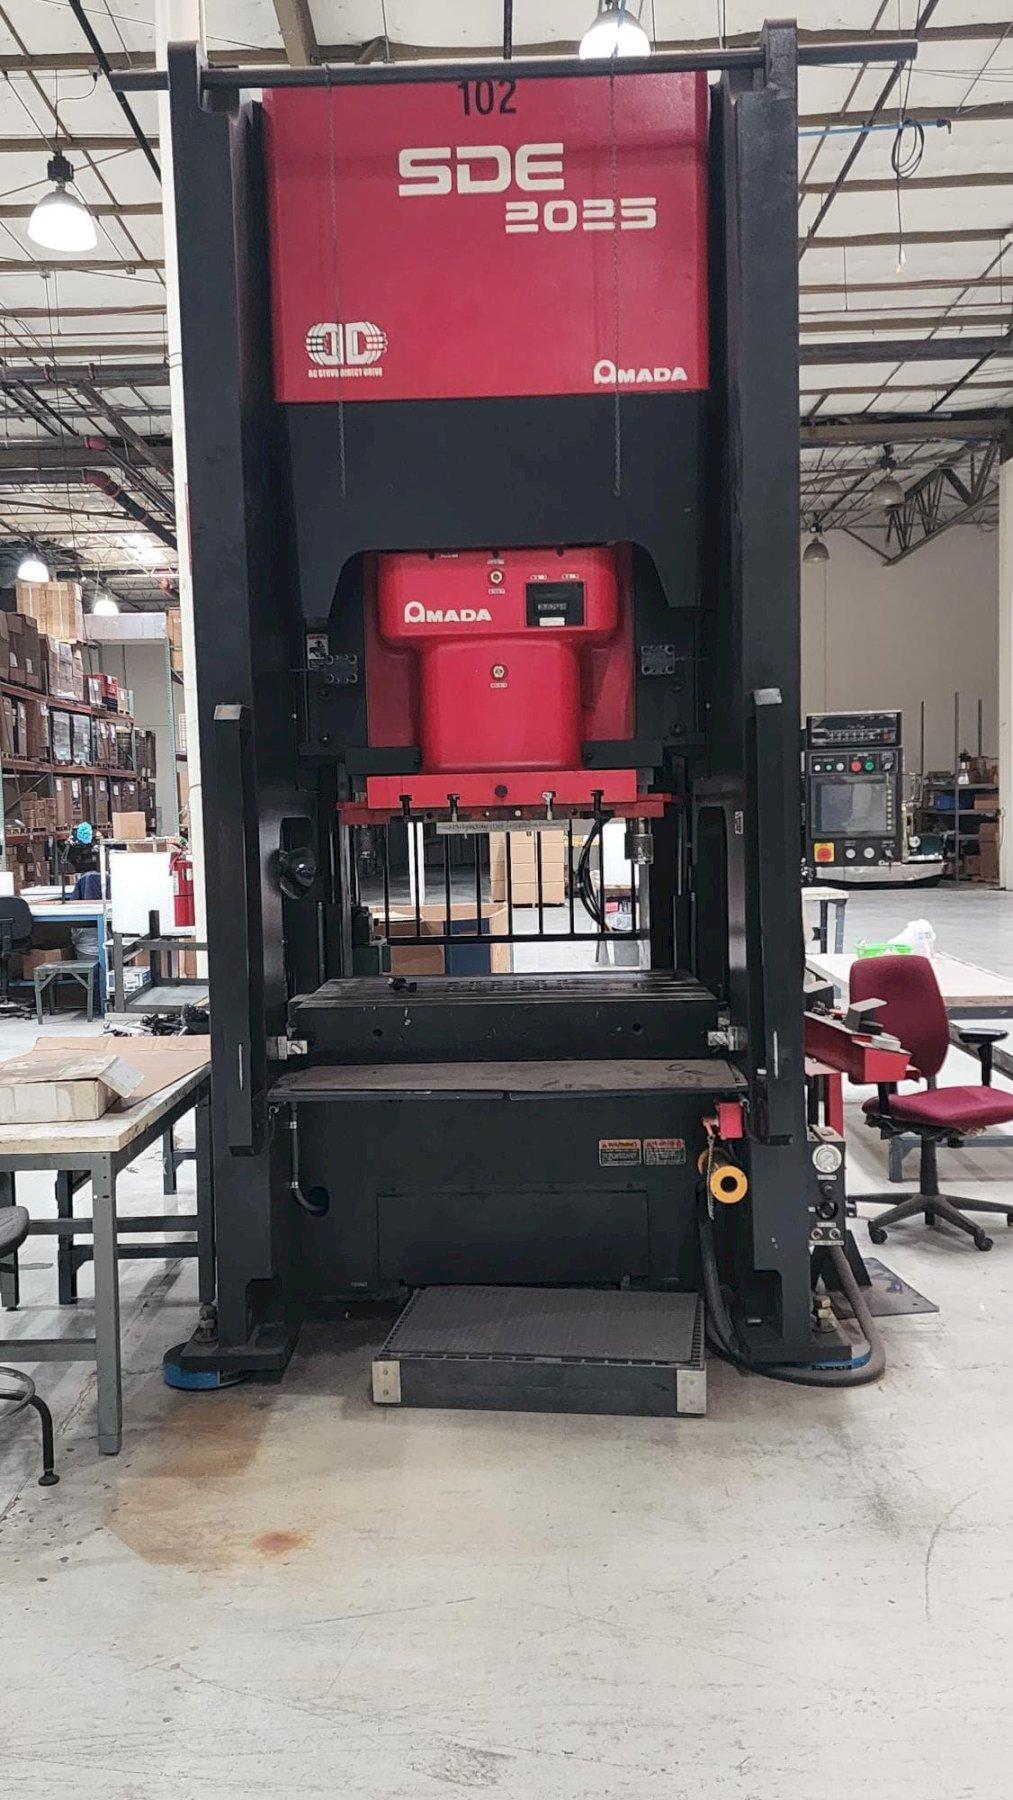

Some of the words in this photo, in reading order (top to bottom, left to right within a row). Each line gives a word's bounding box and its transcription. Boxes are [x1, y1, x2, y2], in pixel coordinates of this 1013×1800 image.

[458, 79, 516, 115] 102
[398, 143, 565, 196] SDE
[505, 197, 657, 233] 2025
[593, 359, 688, 385] AMADA
[404, 600, 492, 624] AMADA
